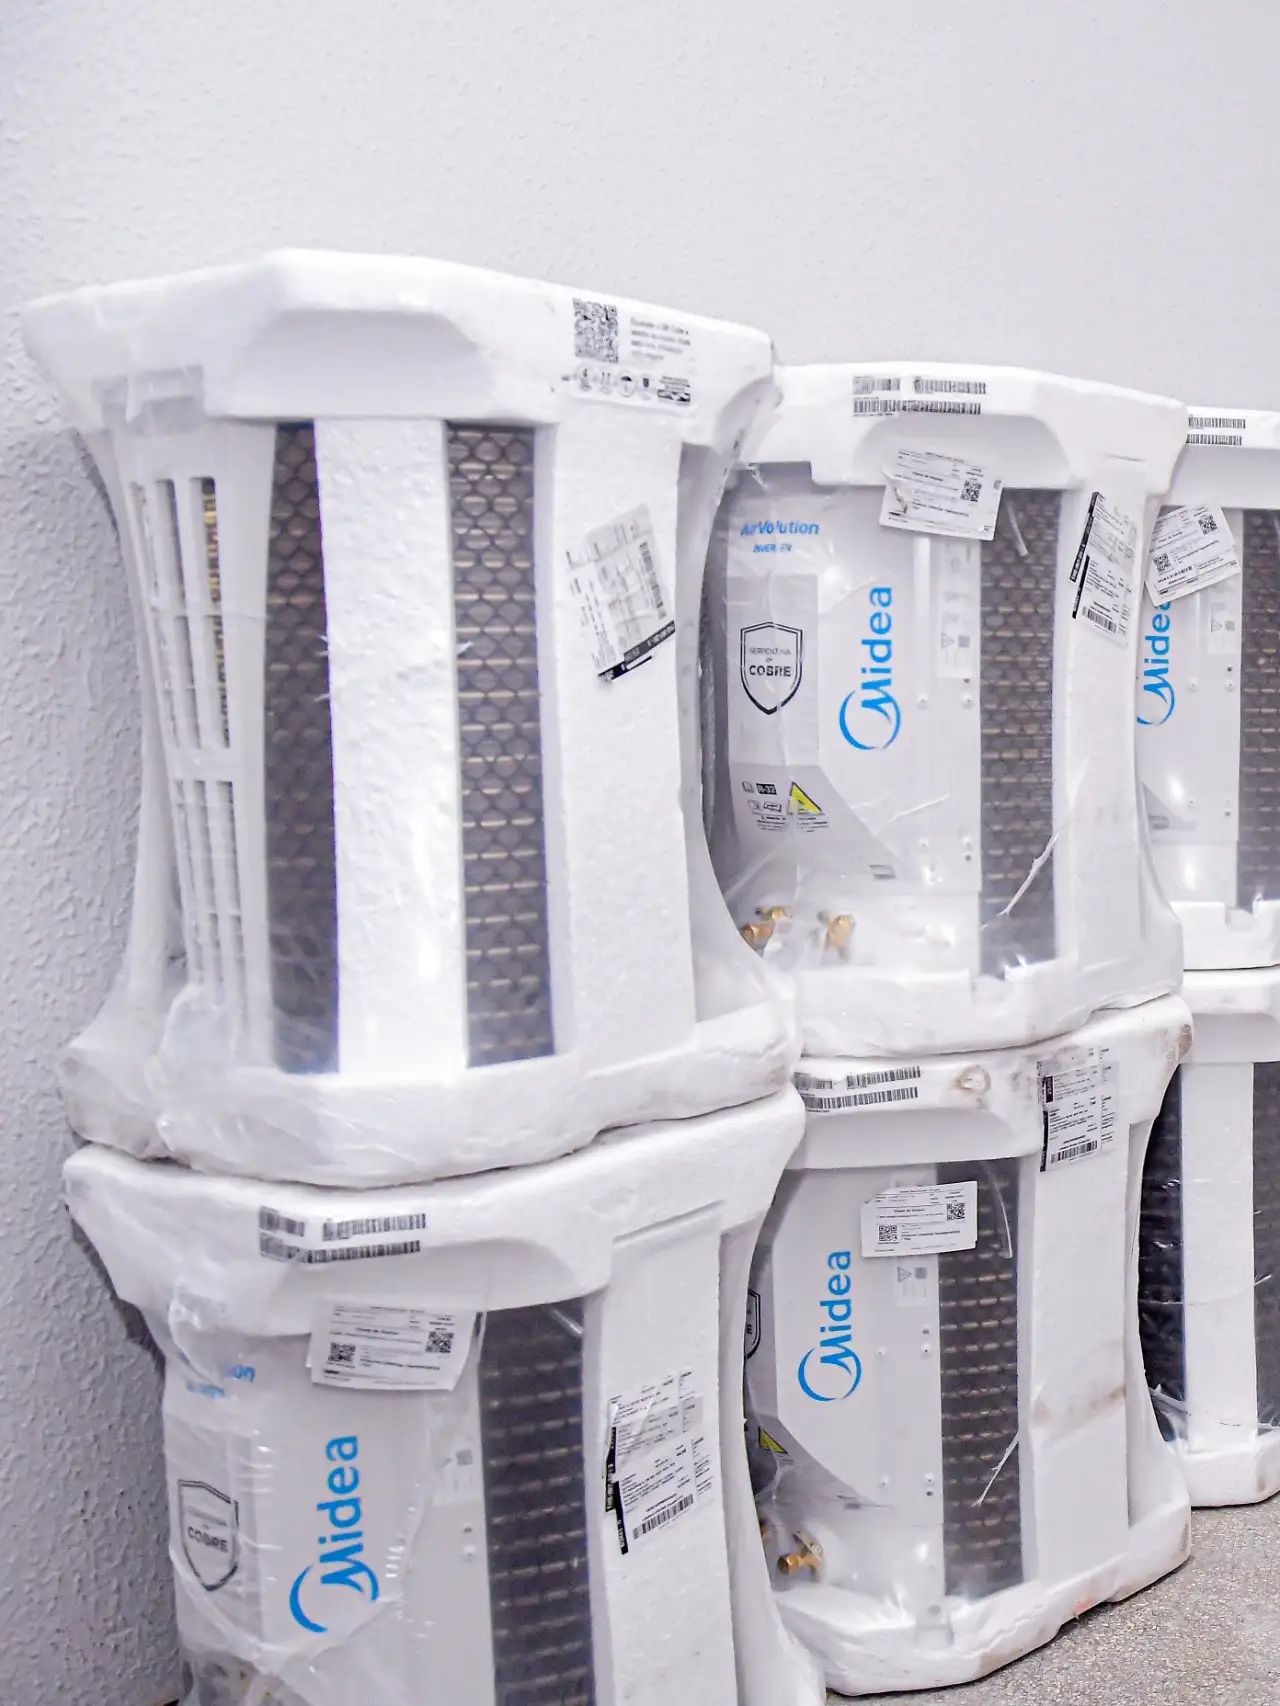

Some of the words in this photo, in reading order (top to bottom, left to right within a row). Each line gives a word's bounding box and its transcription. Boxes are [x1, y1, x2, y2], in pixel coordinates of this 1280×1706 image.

[749, 664, 791, 677] COBRE
[838, 586, 902, 751] Midea
[797, 1249, 863, 1402] Midea
[289, 1435, 380, 1633] Midea
